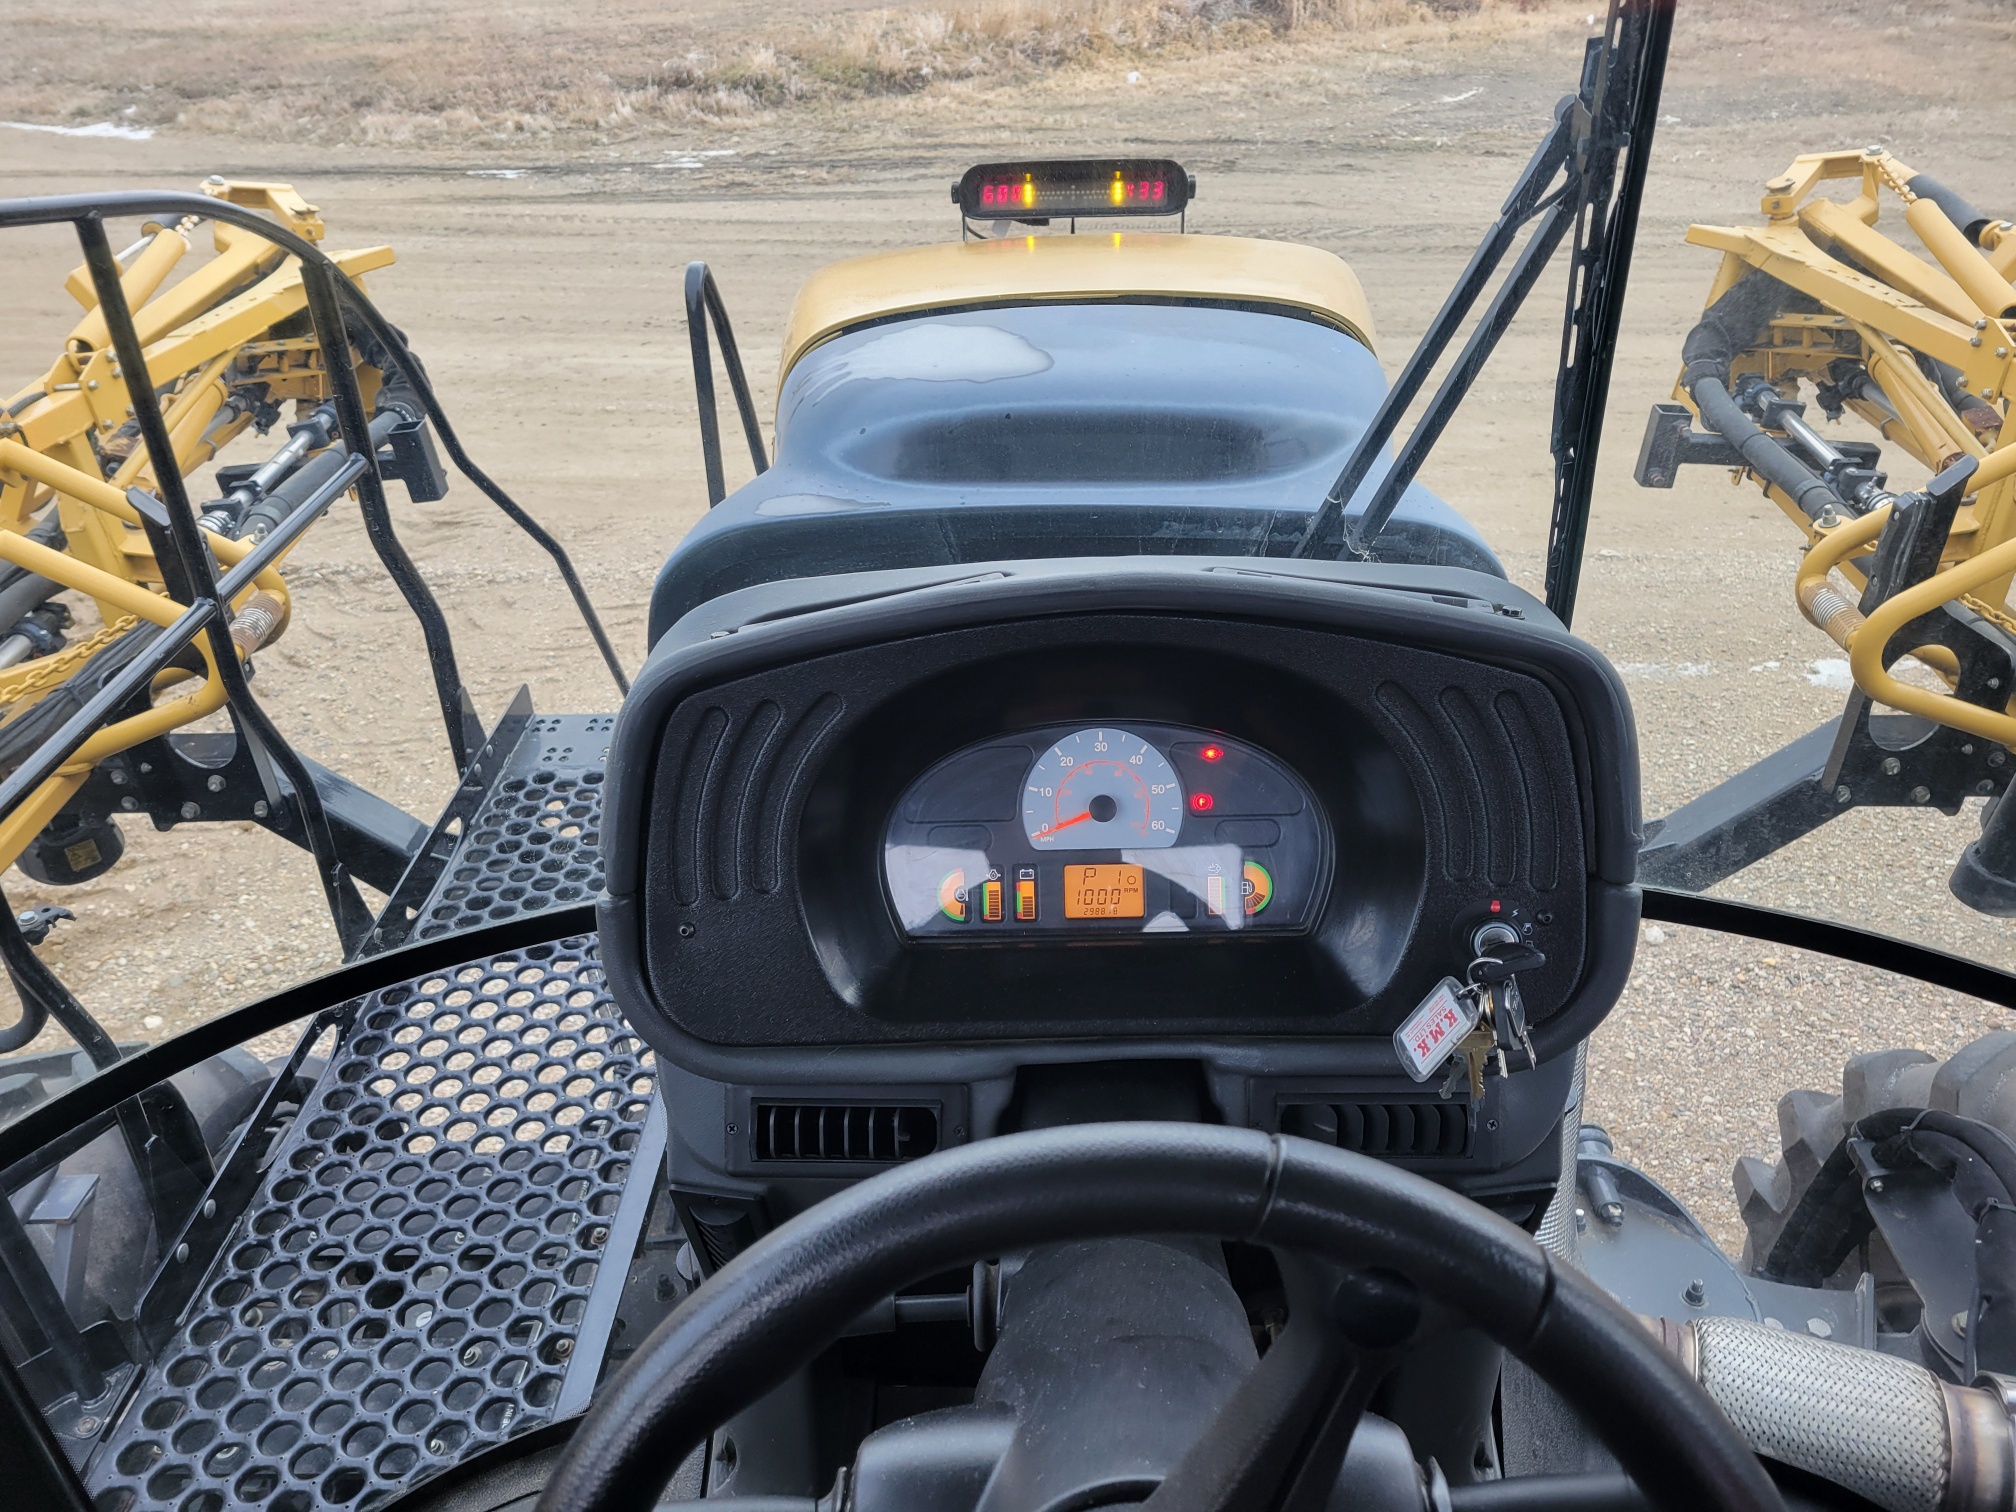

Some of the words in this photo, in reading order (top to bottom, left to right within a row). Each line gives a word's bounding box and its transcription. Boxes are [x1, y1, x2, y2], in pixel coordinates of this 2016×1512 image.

[1094, 742, 1108, 752] 30
[1060, 757, 1074, 767] 20
[1129, 755, 1143, 765] 40
[1039, 787, 1052, 797] 10
[1151, 784, 1165, 794] 50
[1041, 823, 1049, 833] 0
[1151, 820, 1165, 830] 60
[1083, 867, 1097, 885] P
[1077, 888, 1121, 905] 1000
[1425, 1005, 1447, 1030] SALES
[1413, 1008, 1458, 1058] K.M.K.
